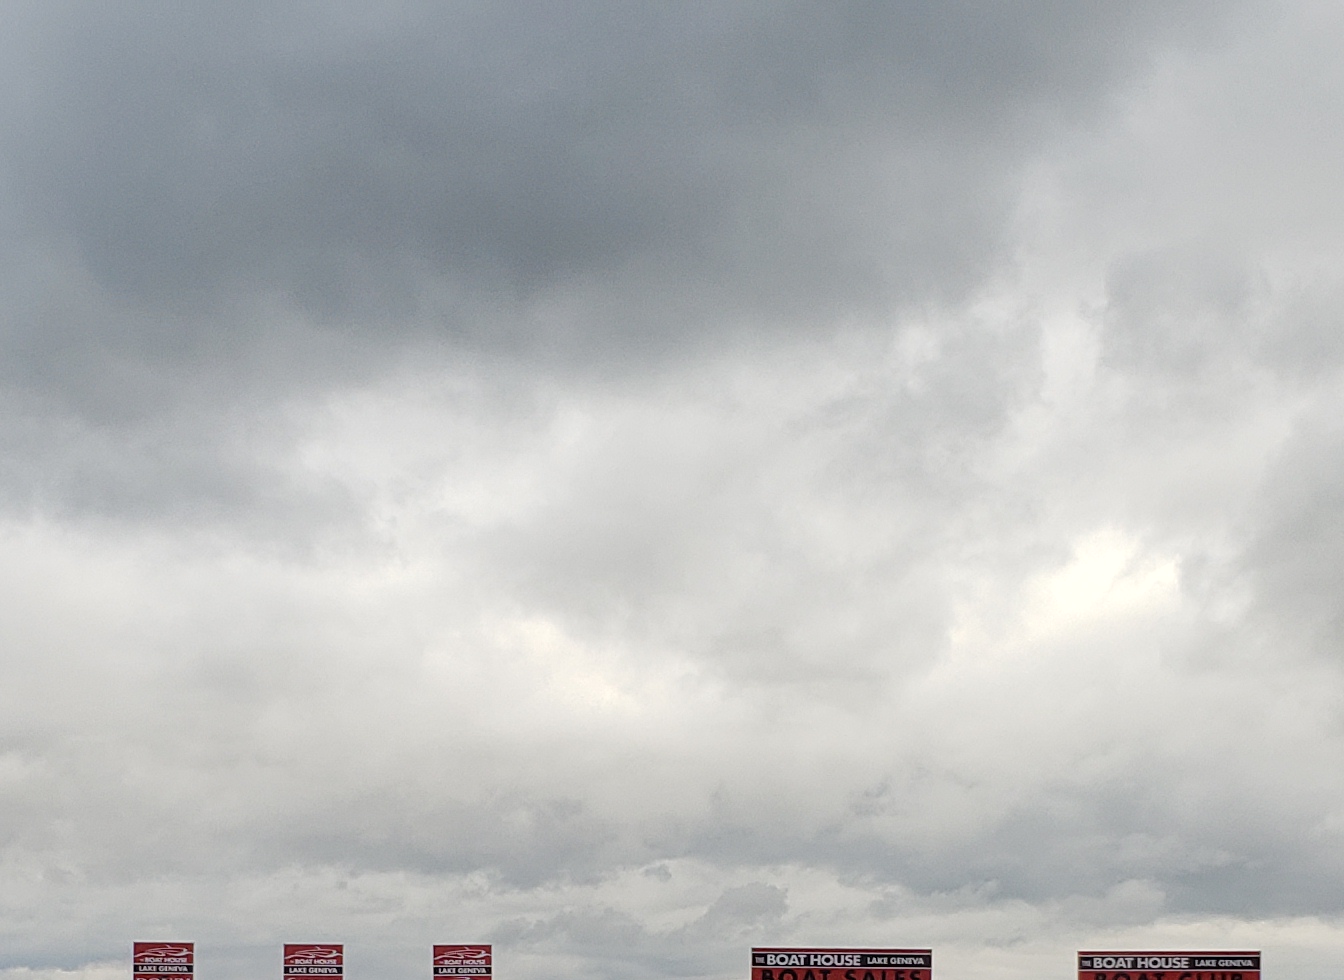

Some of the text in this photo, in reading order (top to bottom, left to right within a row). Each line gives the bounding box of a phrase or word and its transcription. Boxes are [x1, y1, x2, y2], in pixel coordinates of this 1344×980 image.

[766, 954, 807, 966] BOAT
[809, 954, 862, 967] HOUSE
[867, 956, 888, 965] LAKE
[890, 957, 925, 965] GENEVA
[1093, 957, 1135, 969] BOAT
[1137, 957, 1190, 969] HOUSE
[1195, 959, 1217, 967] LAKE
[1218, 959, 1254, 967] GENEVA
